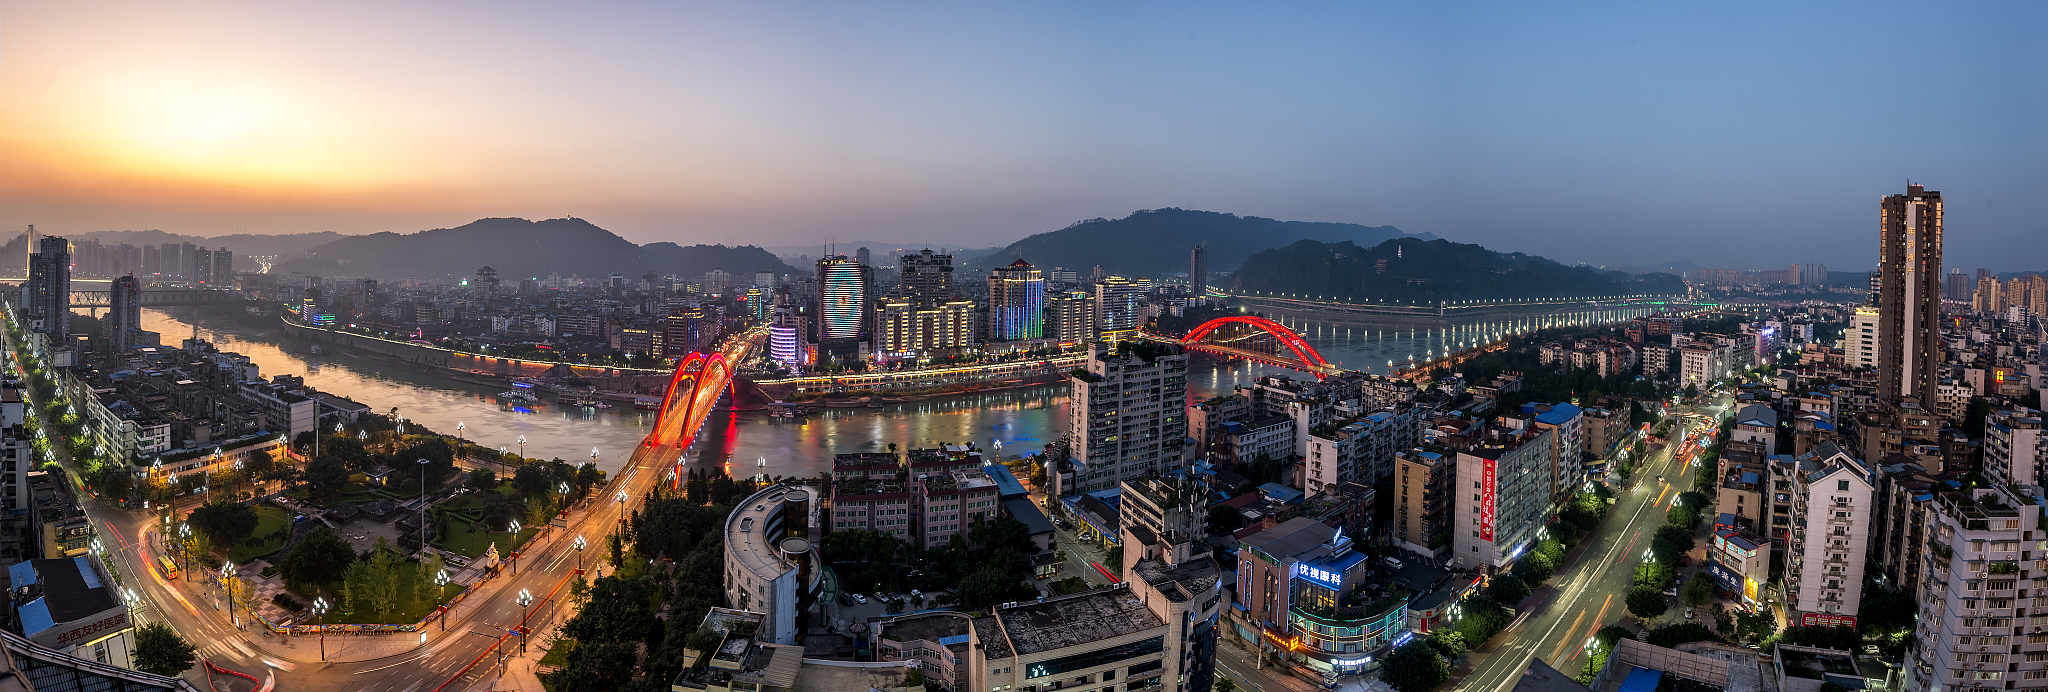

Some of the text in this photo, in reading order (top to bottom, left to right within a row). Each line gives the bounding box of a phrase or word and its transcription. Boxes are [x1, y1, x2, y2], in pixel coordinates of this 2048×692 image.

[1299, 563, 1341, 586] 优视眼科
[57, 613, 126, 645] 华西友好医院
